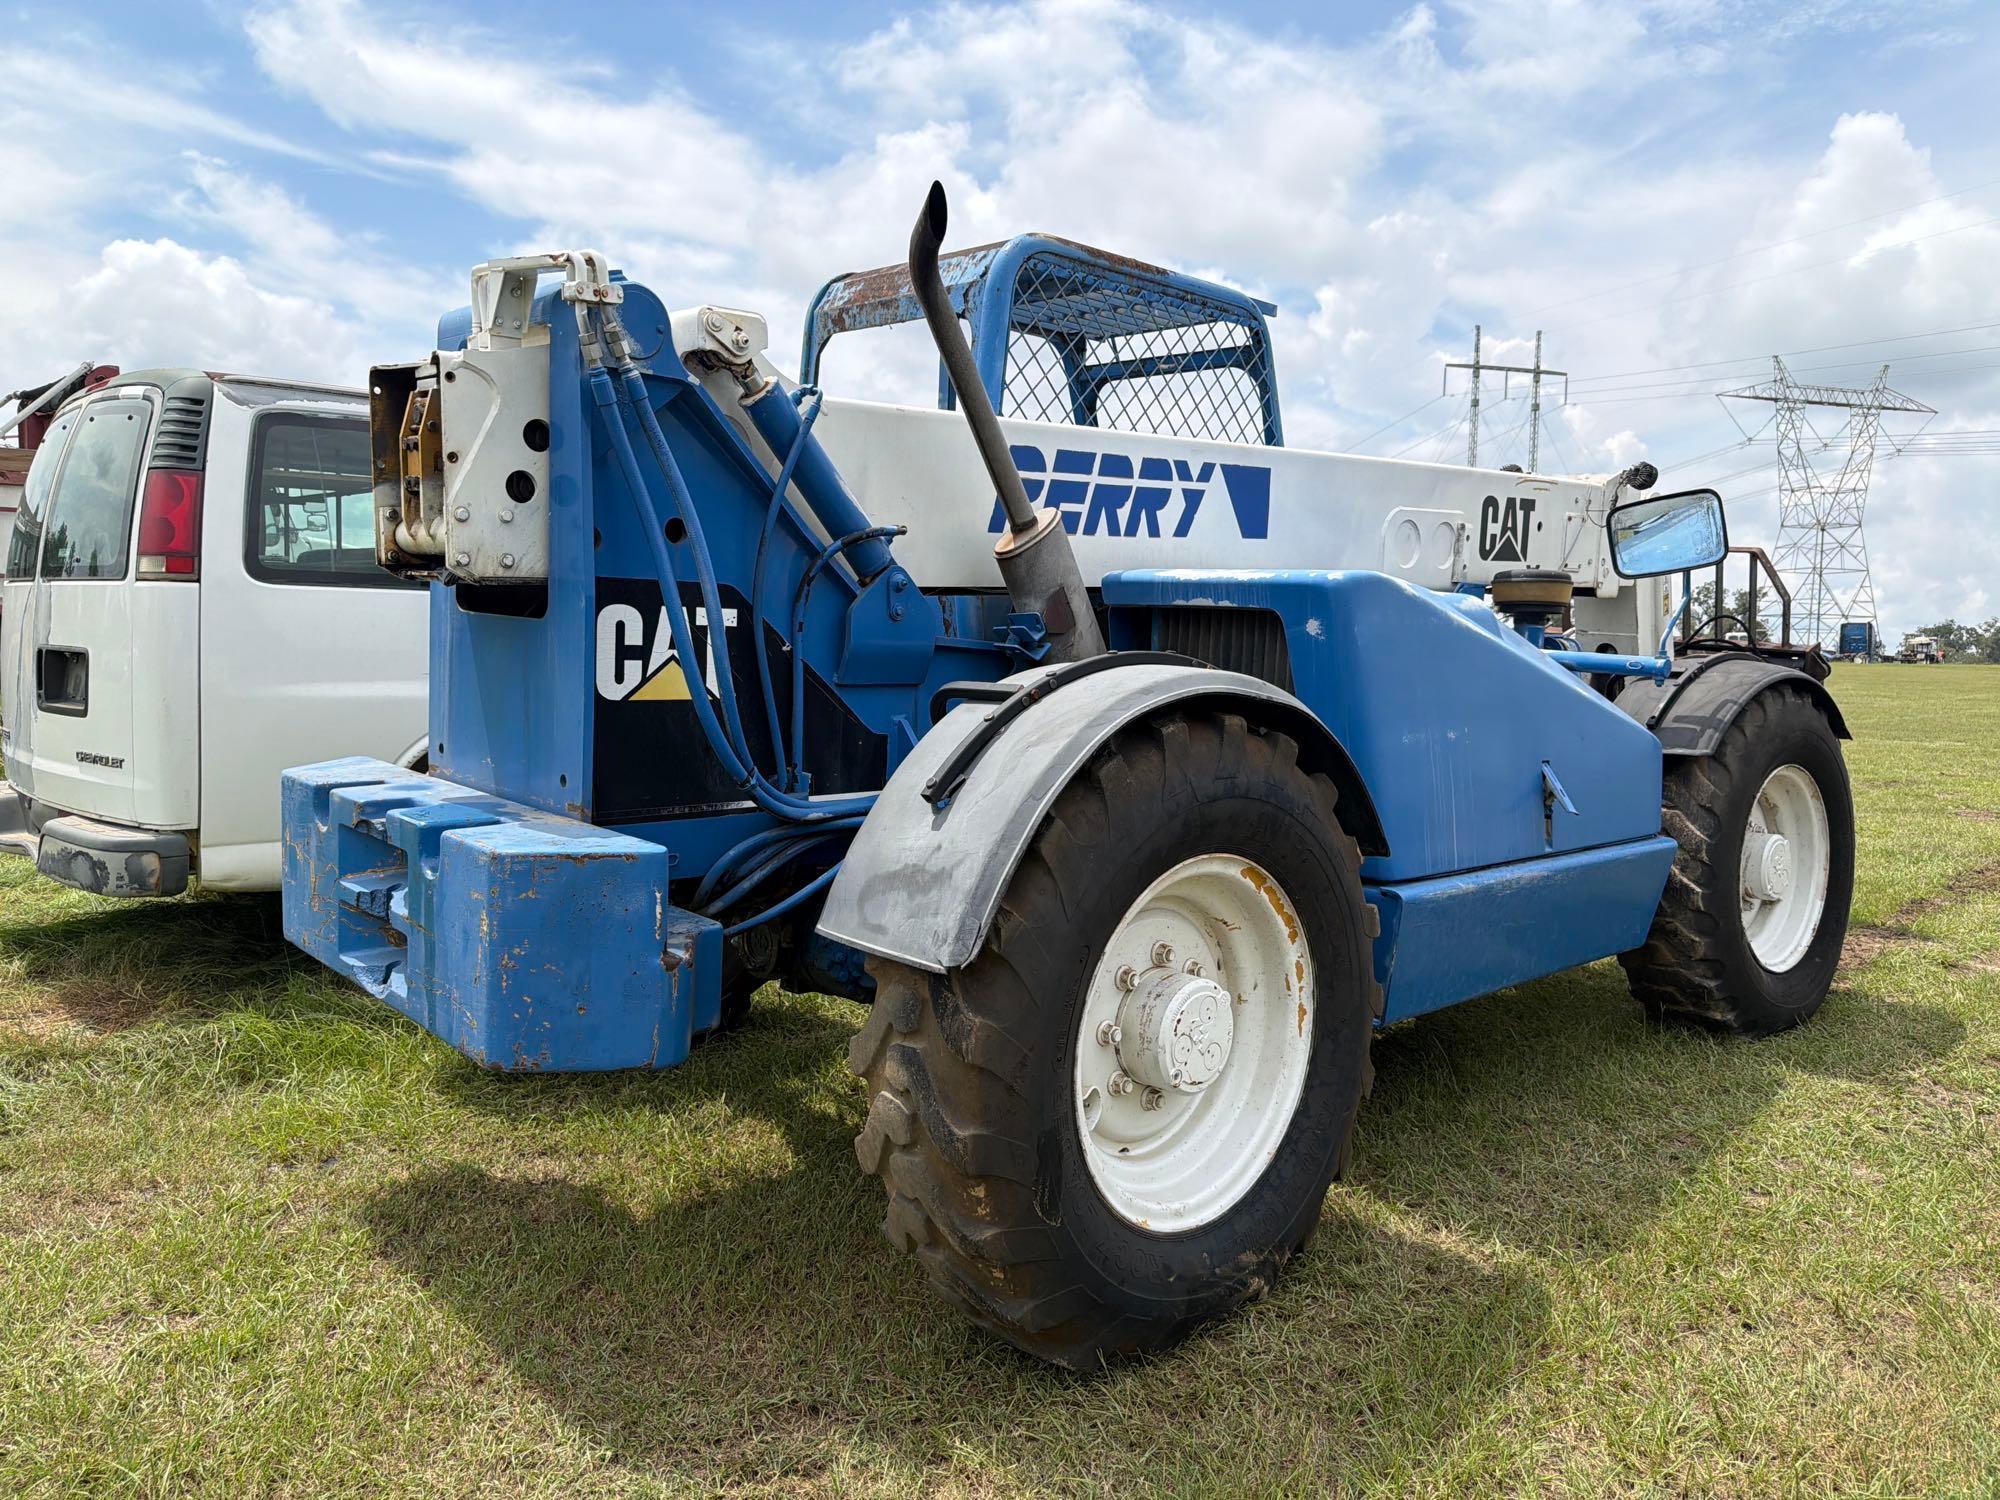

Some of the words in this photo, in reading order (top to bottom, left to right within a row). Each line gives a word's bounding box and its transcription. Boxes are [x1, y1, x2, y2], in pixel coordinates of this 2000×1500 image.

[988, 445, 1216, 538] PERRY
[1479, 495, 1536, 561] CAT
[596, 603, 738, 700] CAT
